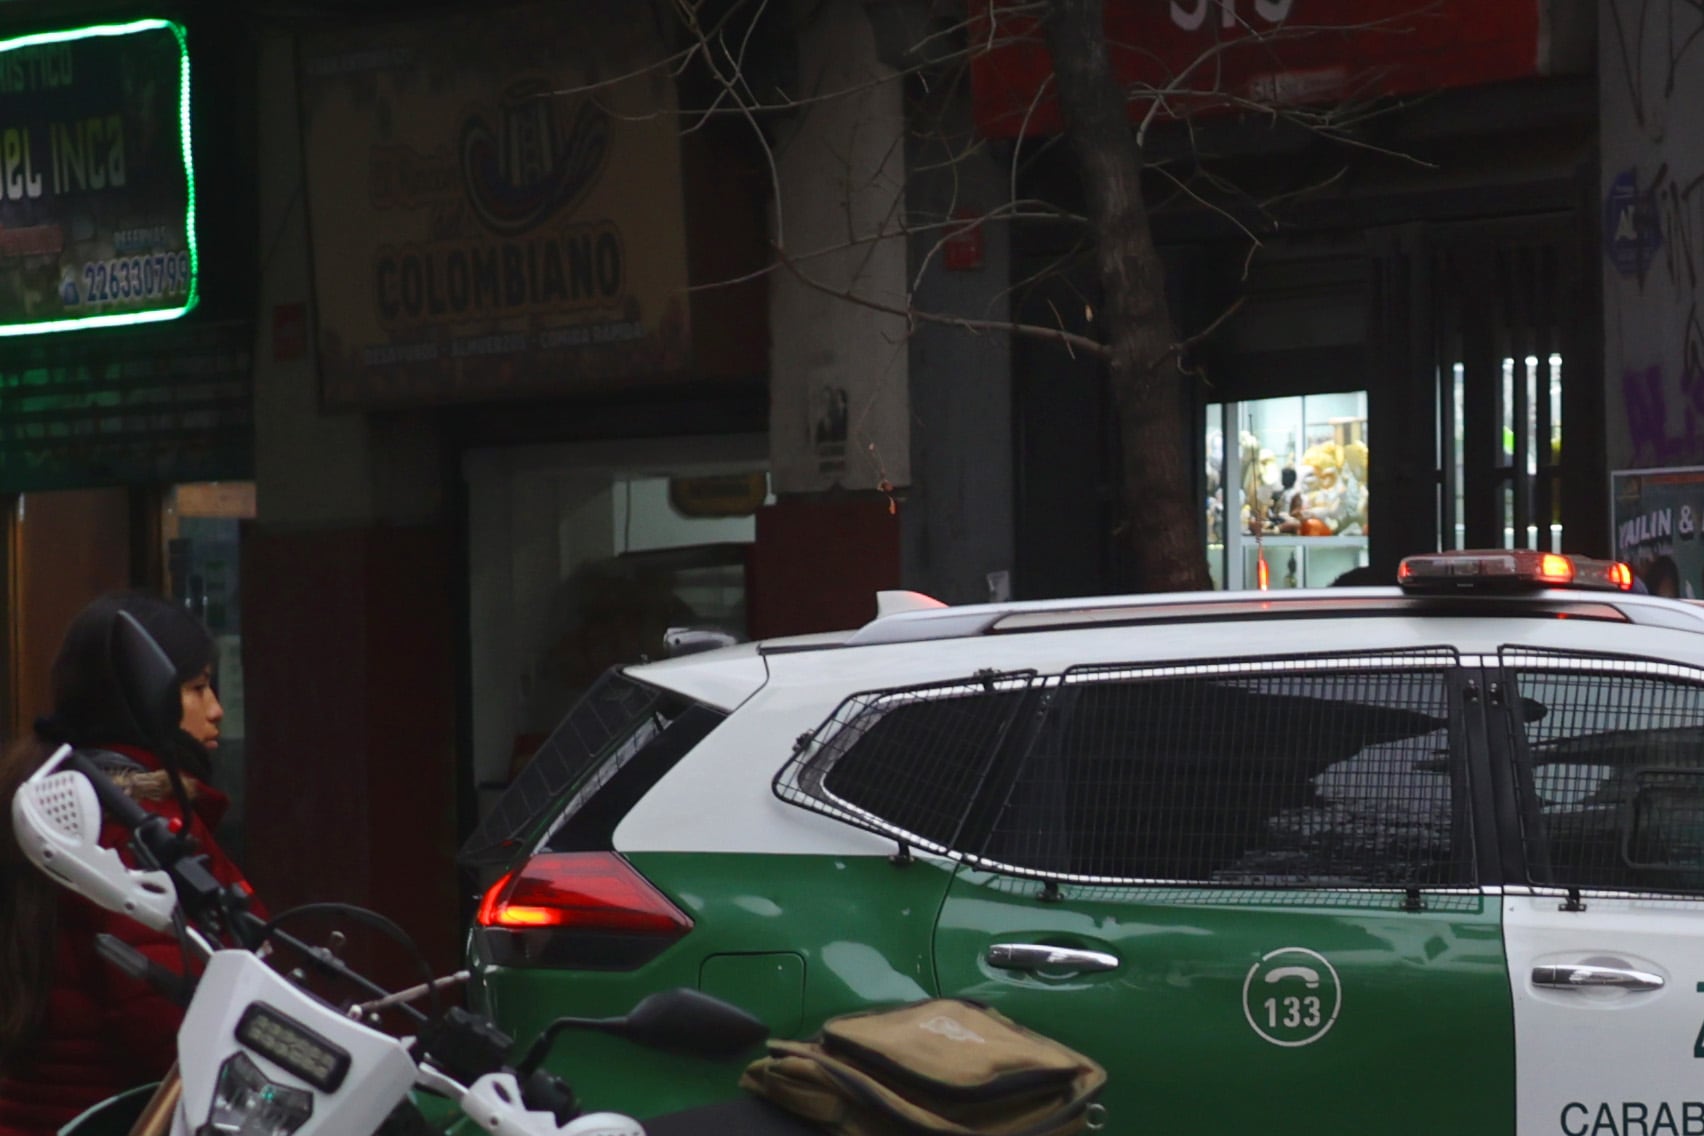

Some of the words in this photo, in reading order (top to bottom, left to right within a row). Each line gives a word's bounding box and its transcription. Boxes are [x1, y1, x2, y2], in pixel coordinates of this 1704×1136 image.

[84, 251, 188, 303] 226330799
[377, 231, 620, 318] COLOMBIANO
[1264, 996, 1321, 1028] 133
